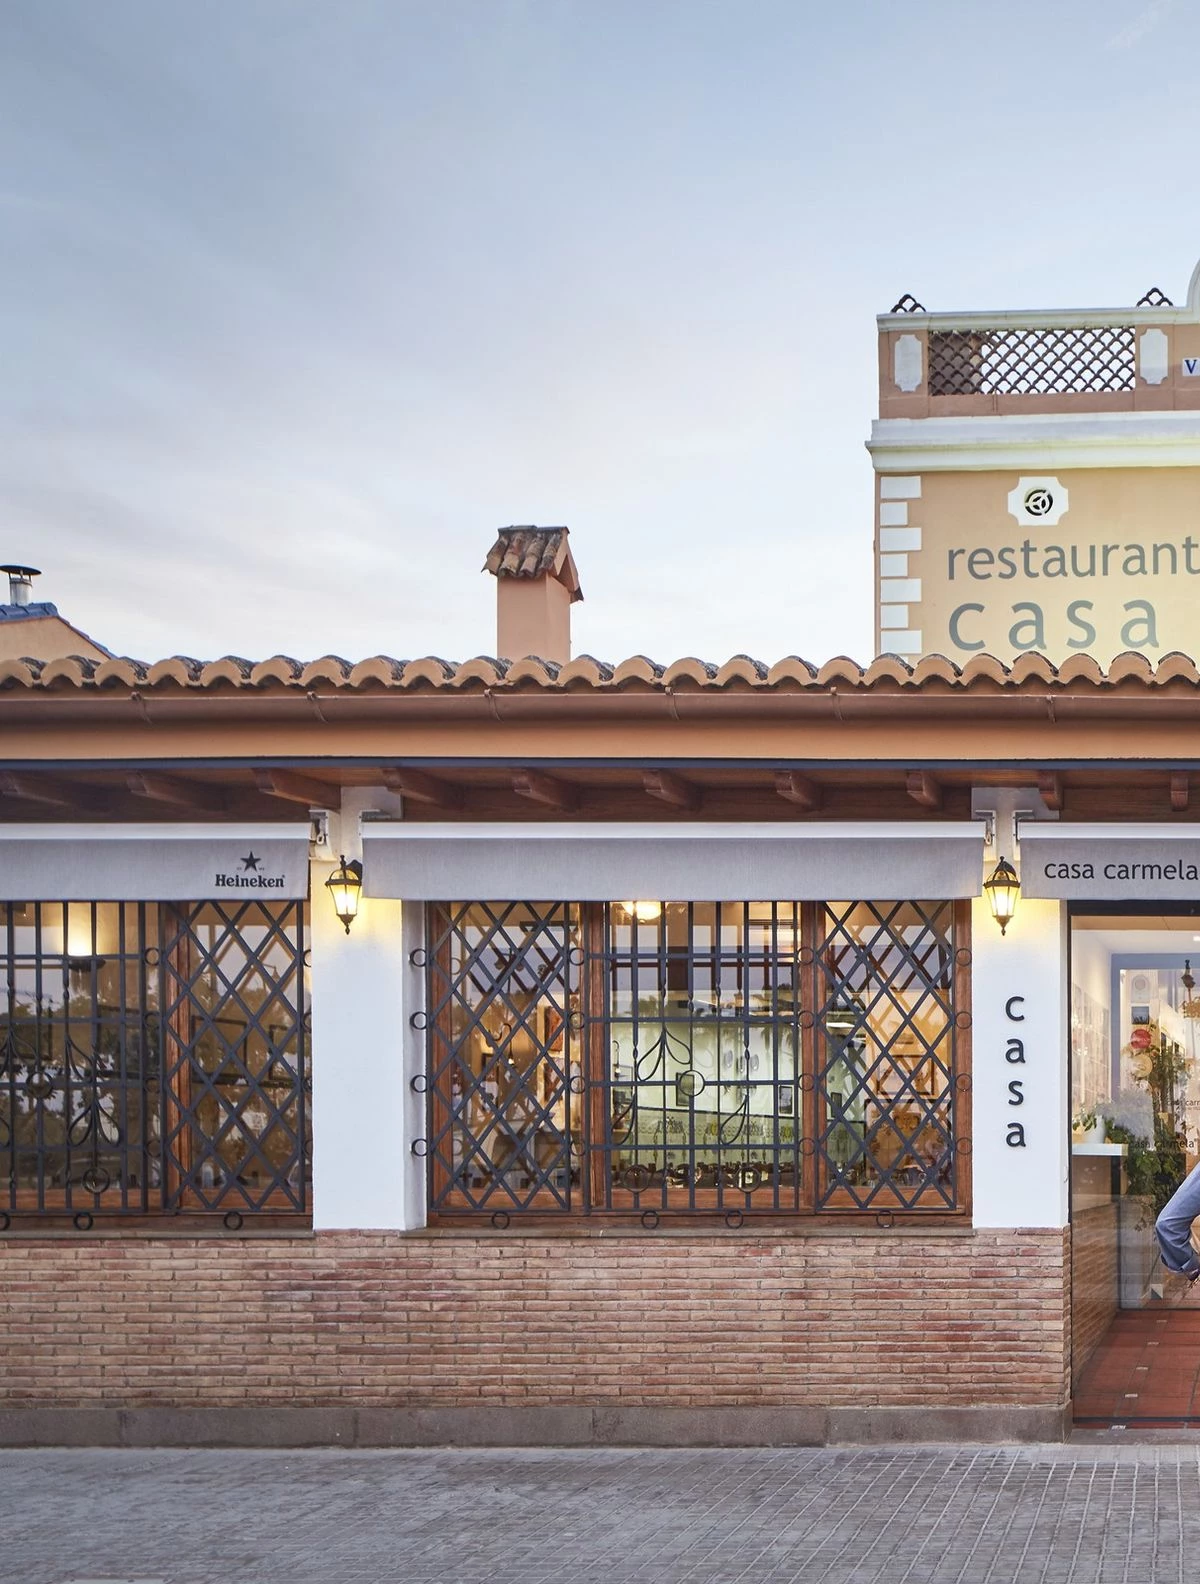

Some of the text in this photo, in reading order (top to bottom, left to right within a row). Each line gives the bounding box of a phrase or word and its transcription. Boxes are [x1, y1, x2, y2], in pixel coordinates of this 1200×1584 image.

[948, 599, 1160, 651] casa
[214, 874, 285, 888] Heineken
[1044, 859, 1199, 881] casa carmela
[1005, 996, 1026, 1148] casa
